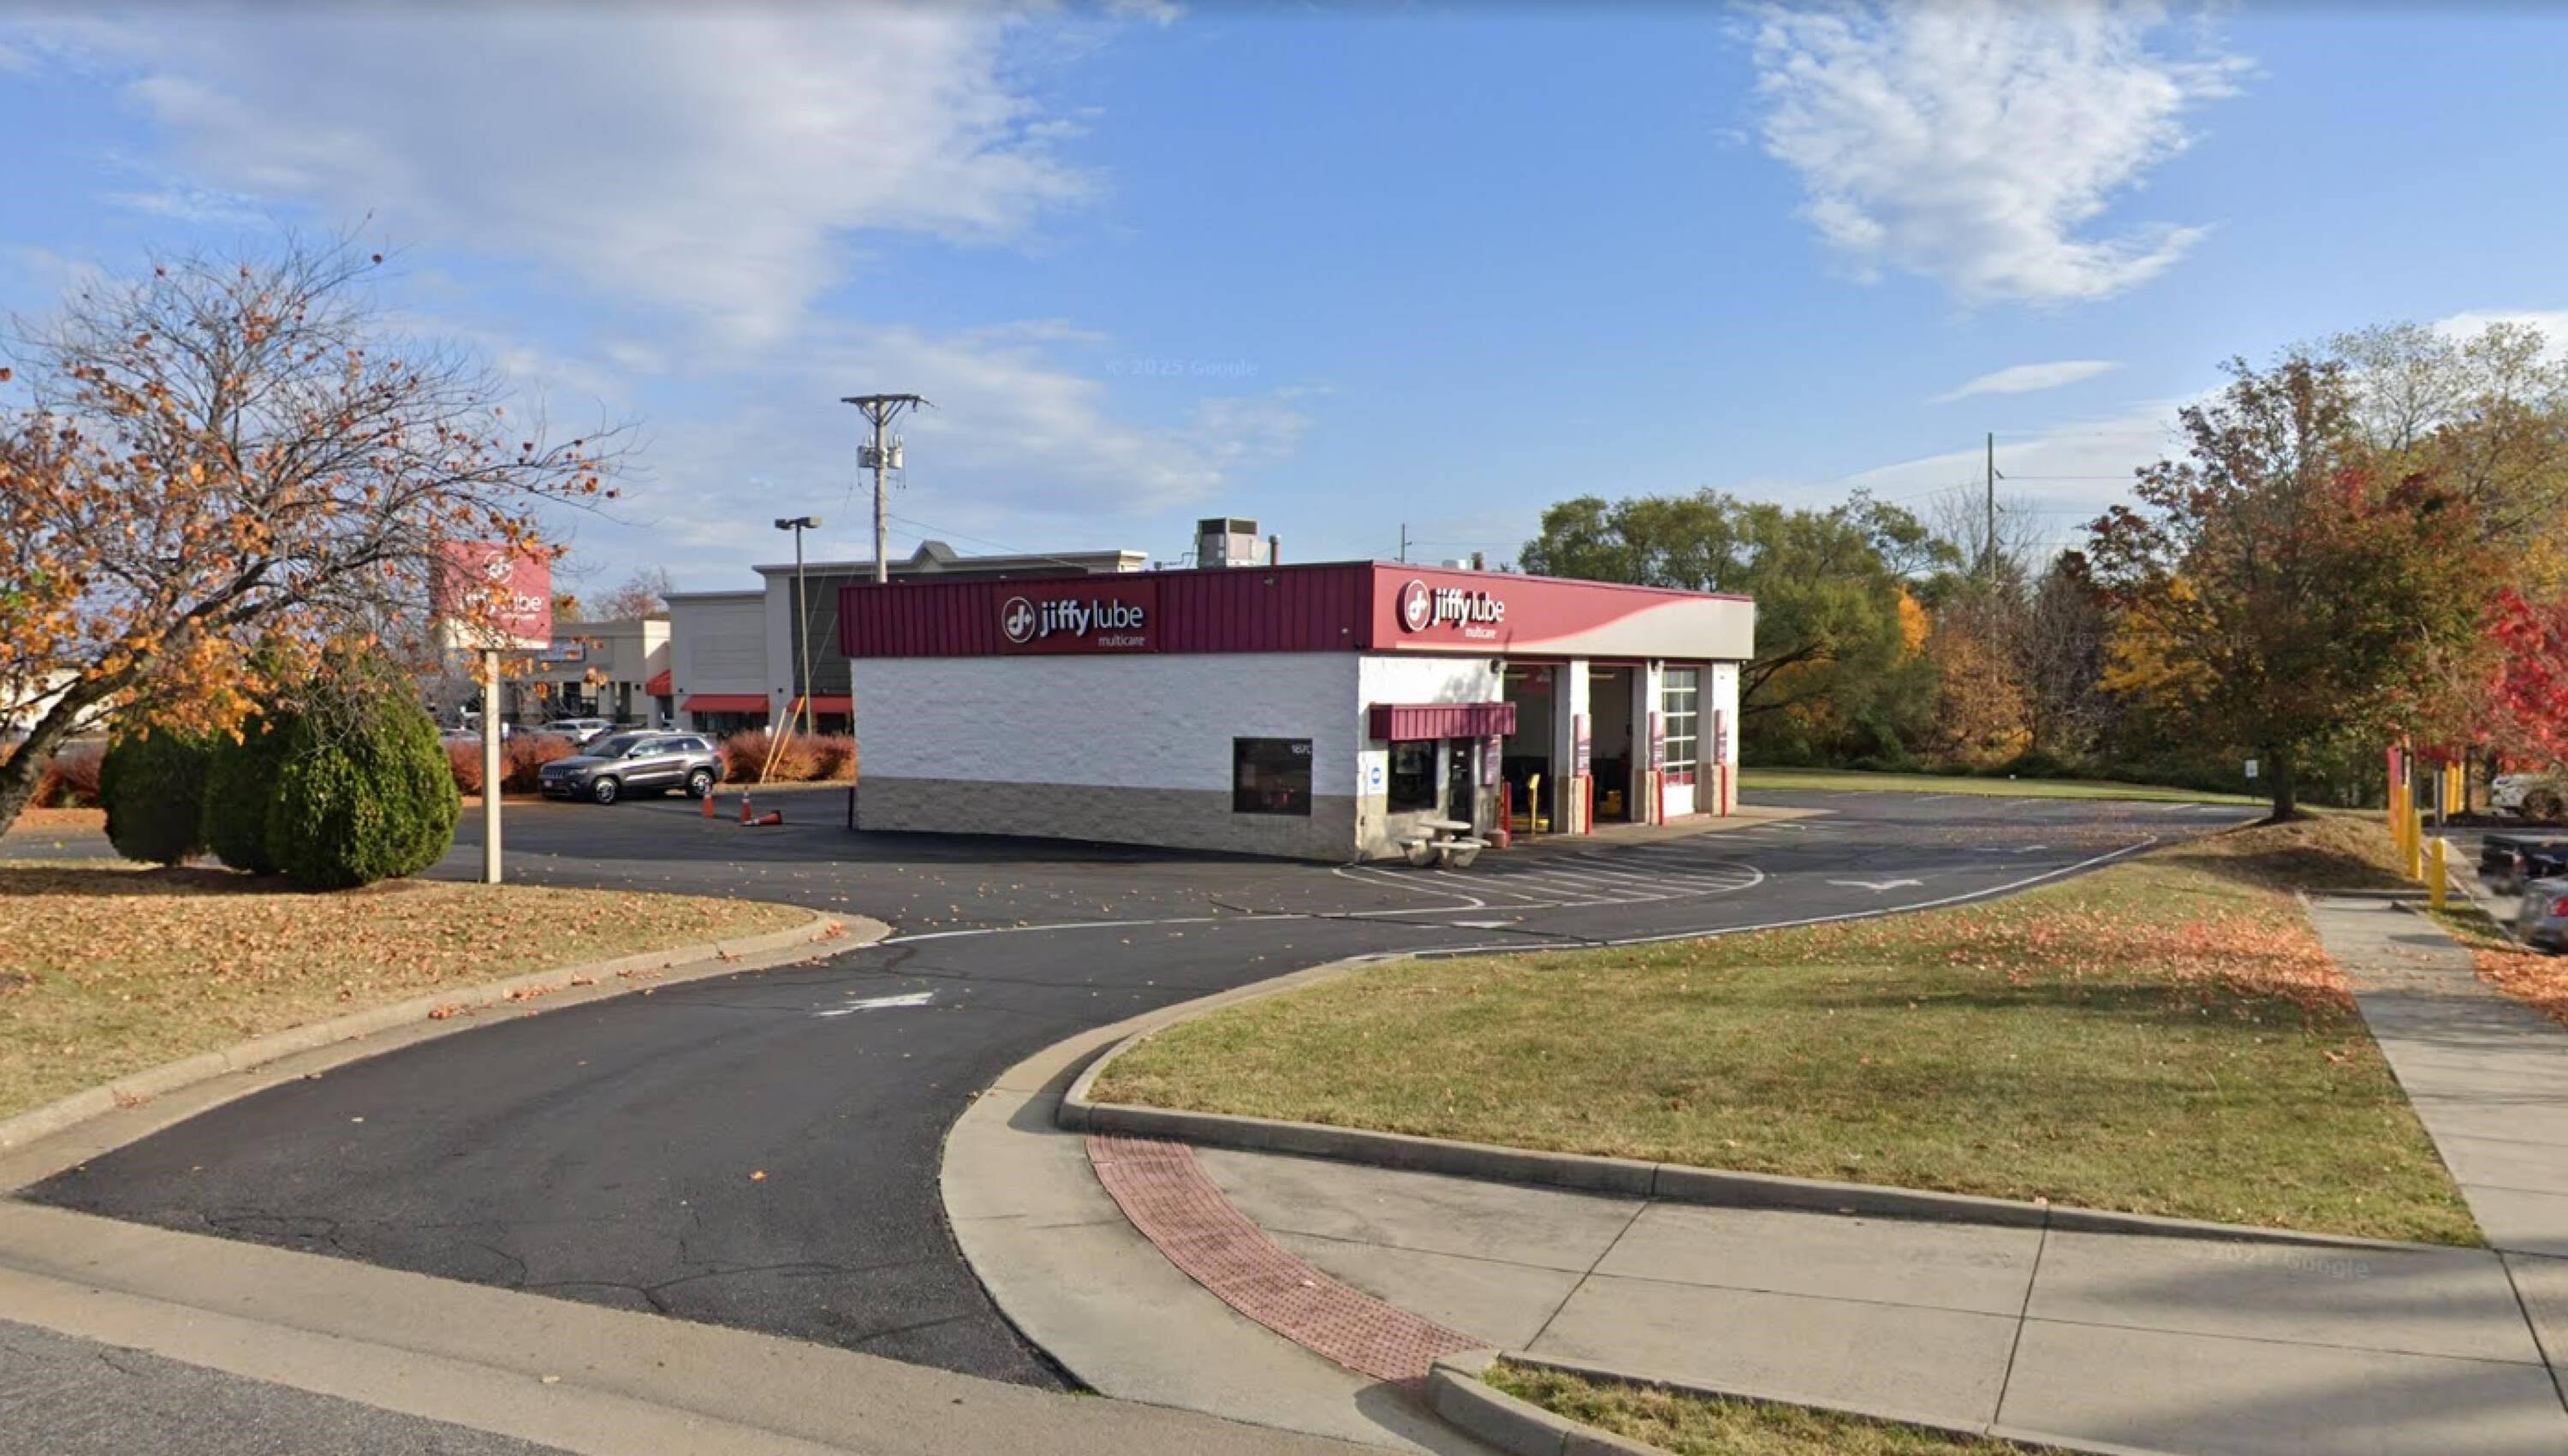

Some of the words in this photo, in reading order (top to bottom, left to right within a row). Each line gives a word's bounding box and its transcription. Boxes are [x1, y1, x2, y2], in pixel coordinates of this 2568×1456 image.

[1039, 600, 1090, 638] jiffy
[1092, 599, 1144, 628] lube
[1098, 633, 1145, 647] multicare
